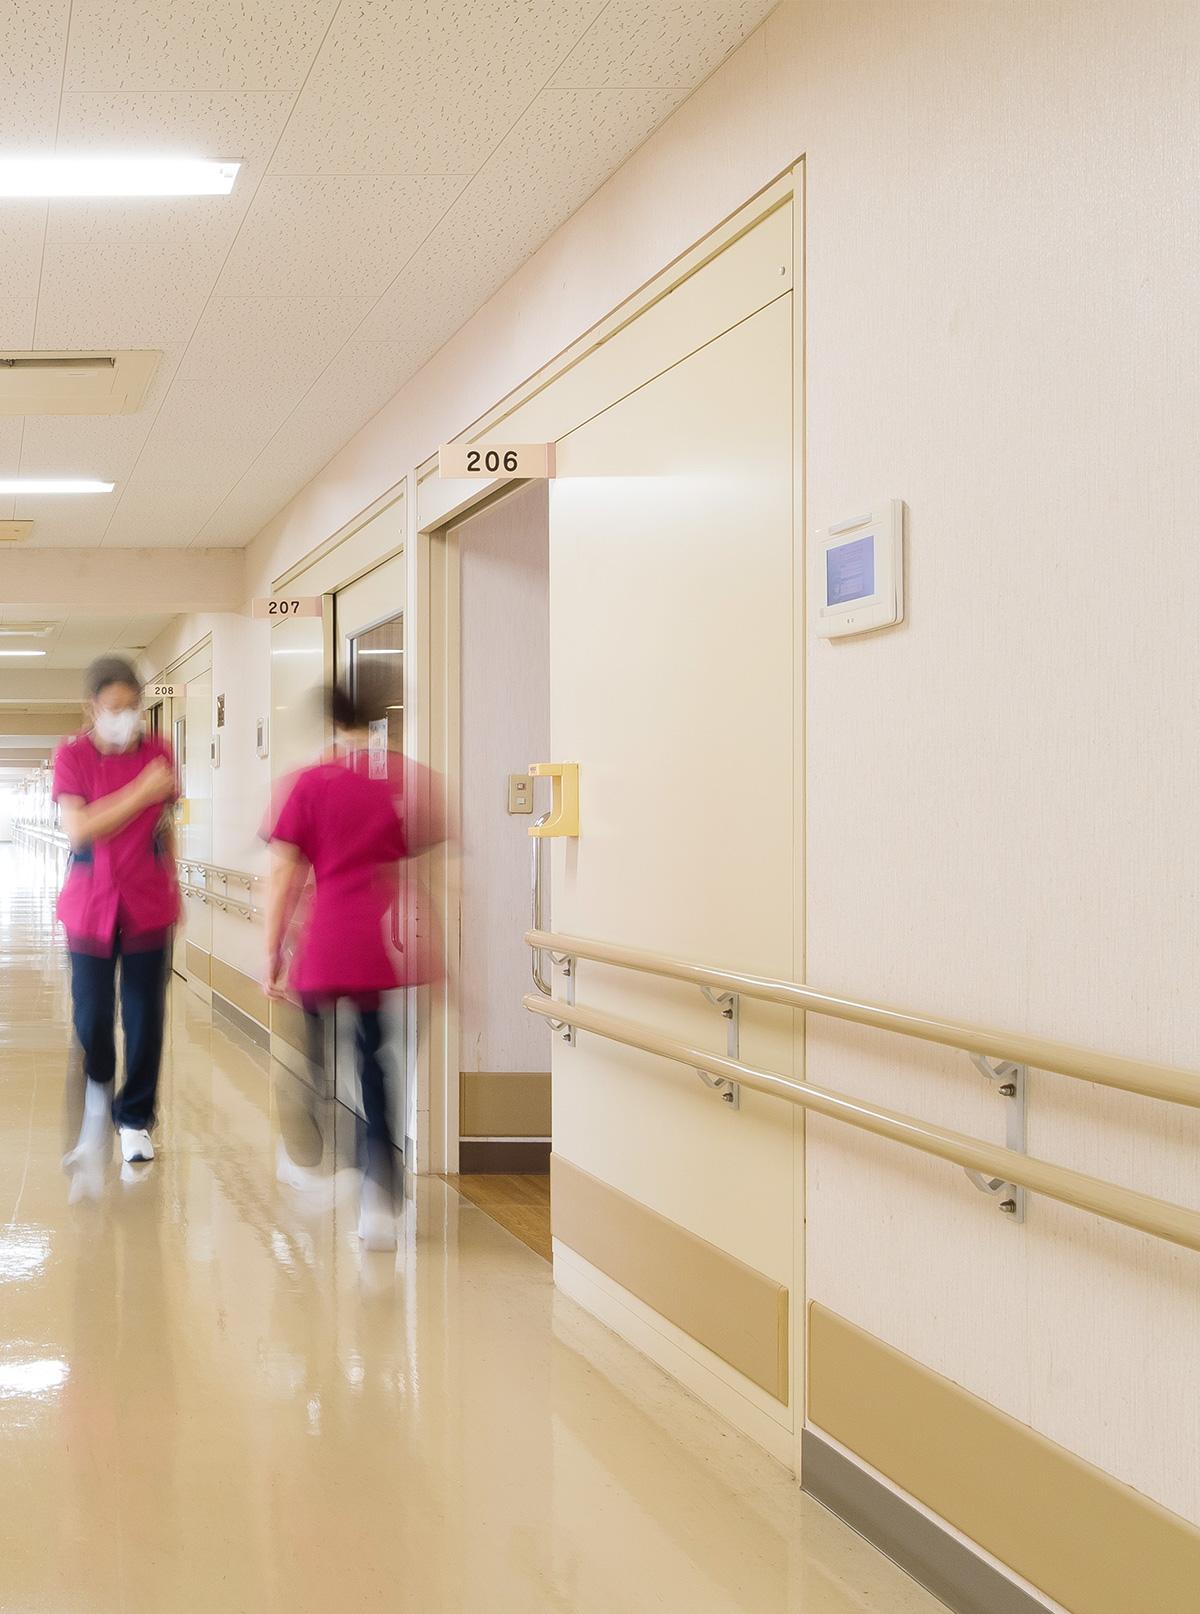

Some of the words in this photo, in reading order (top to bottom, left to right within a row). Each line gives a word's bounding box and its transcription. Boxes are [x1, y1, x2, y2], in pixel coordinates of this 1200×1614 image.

[466, 450, 518, 472] 206
[268, 601, 300, 614] 207
[154, 686, 174, 695] 208
